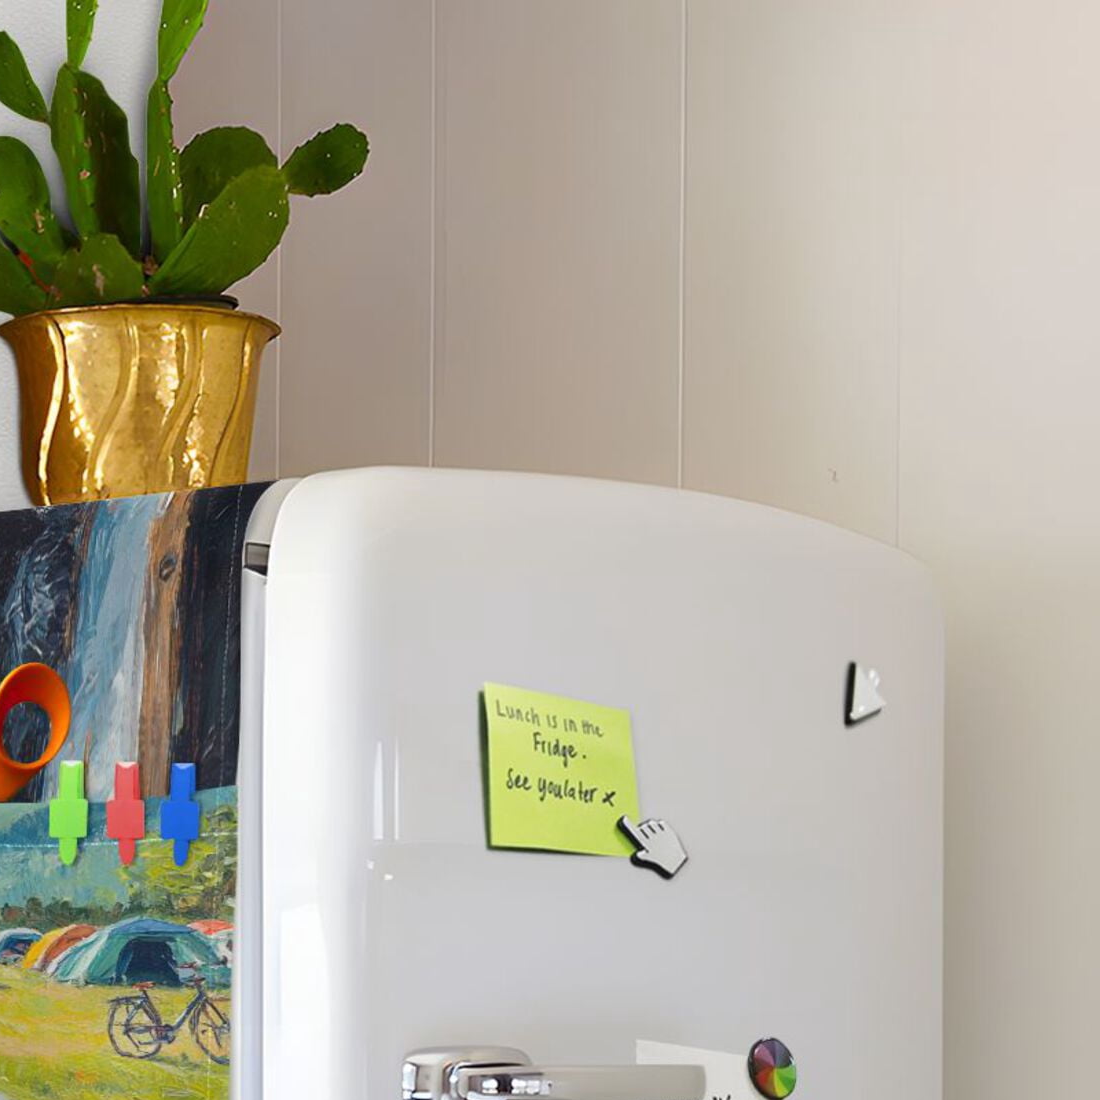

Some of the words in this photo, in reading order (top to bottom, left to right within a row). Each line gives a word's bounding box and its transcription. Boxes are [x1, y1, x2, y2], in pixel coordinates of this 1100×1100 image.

[495, 698, 540, 727] Lunch
[563, 717, 578, 733] in
[581, 719, 604, 738] the
[505, 767, 532, 791] See
